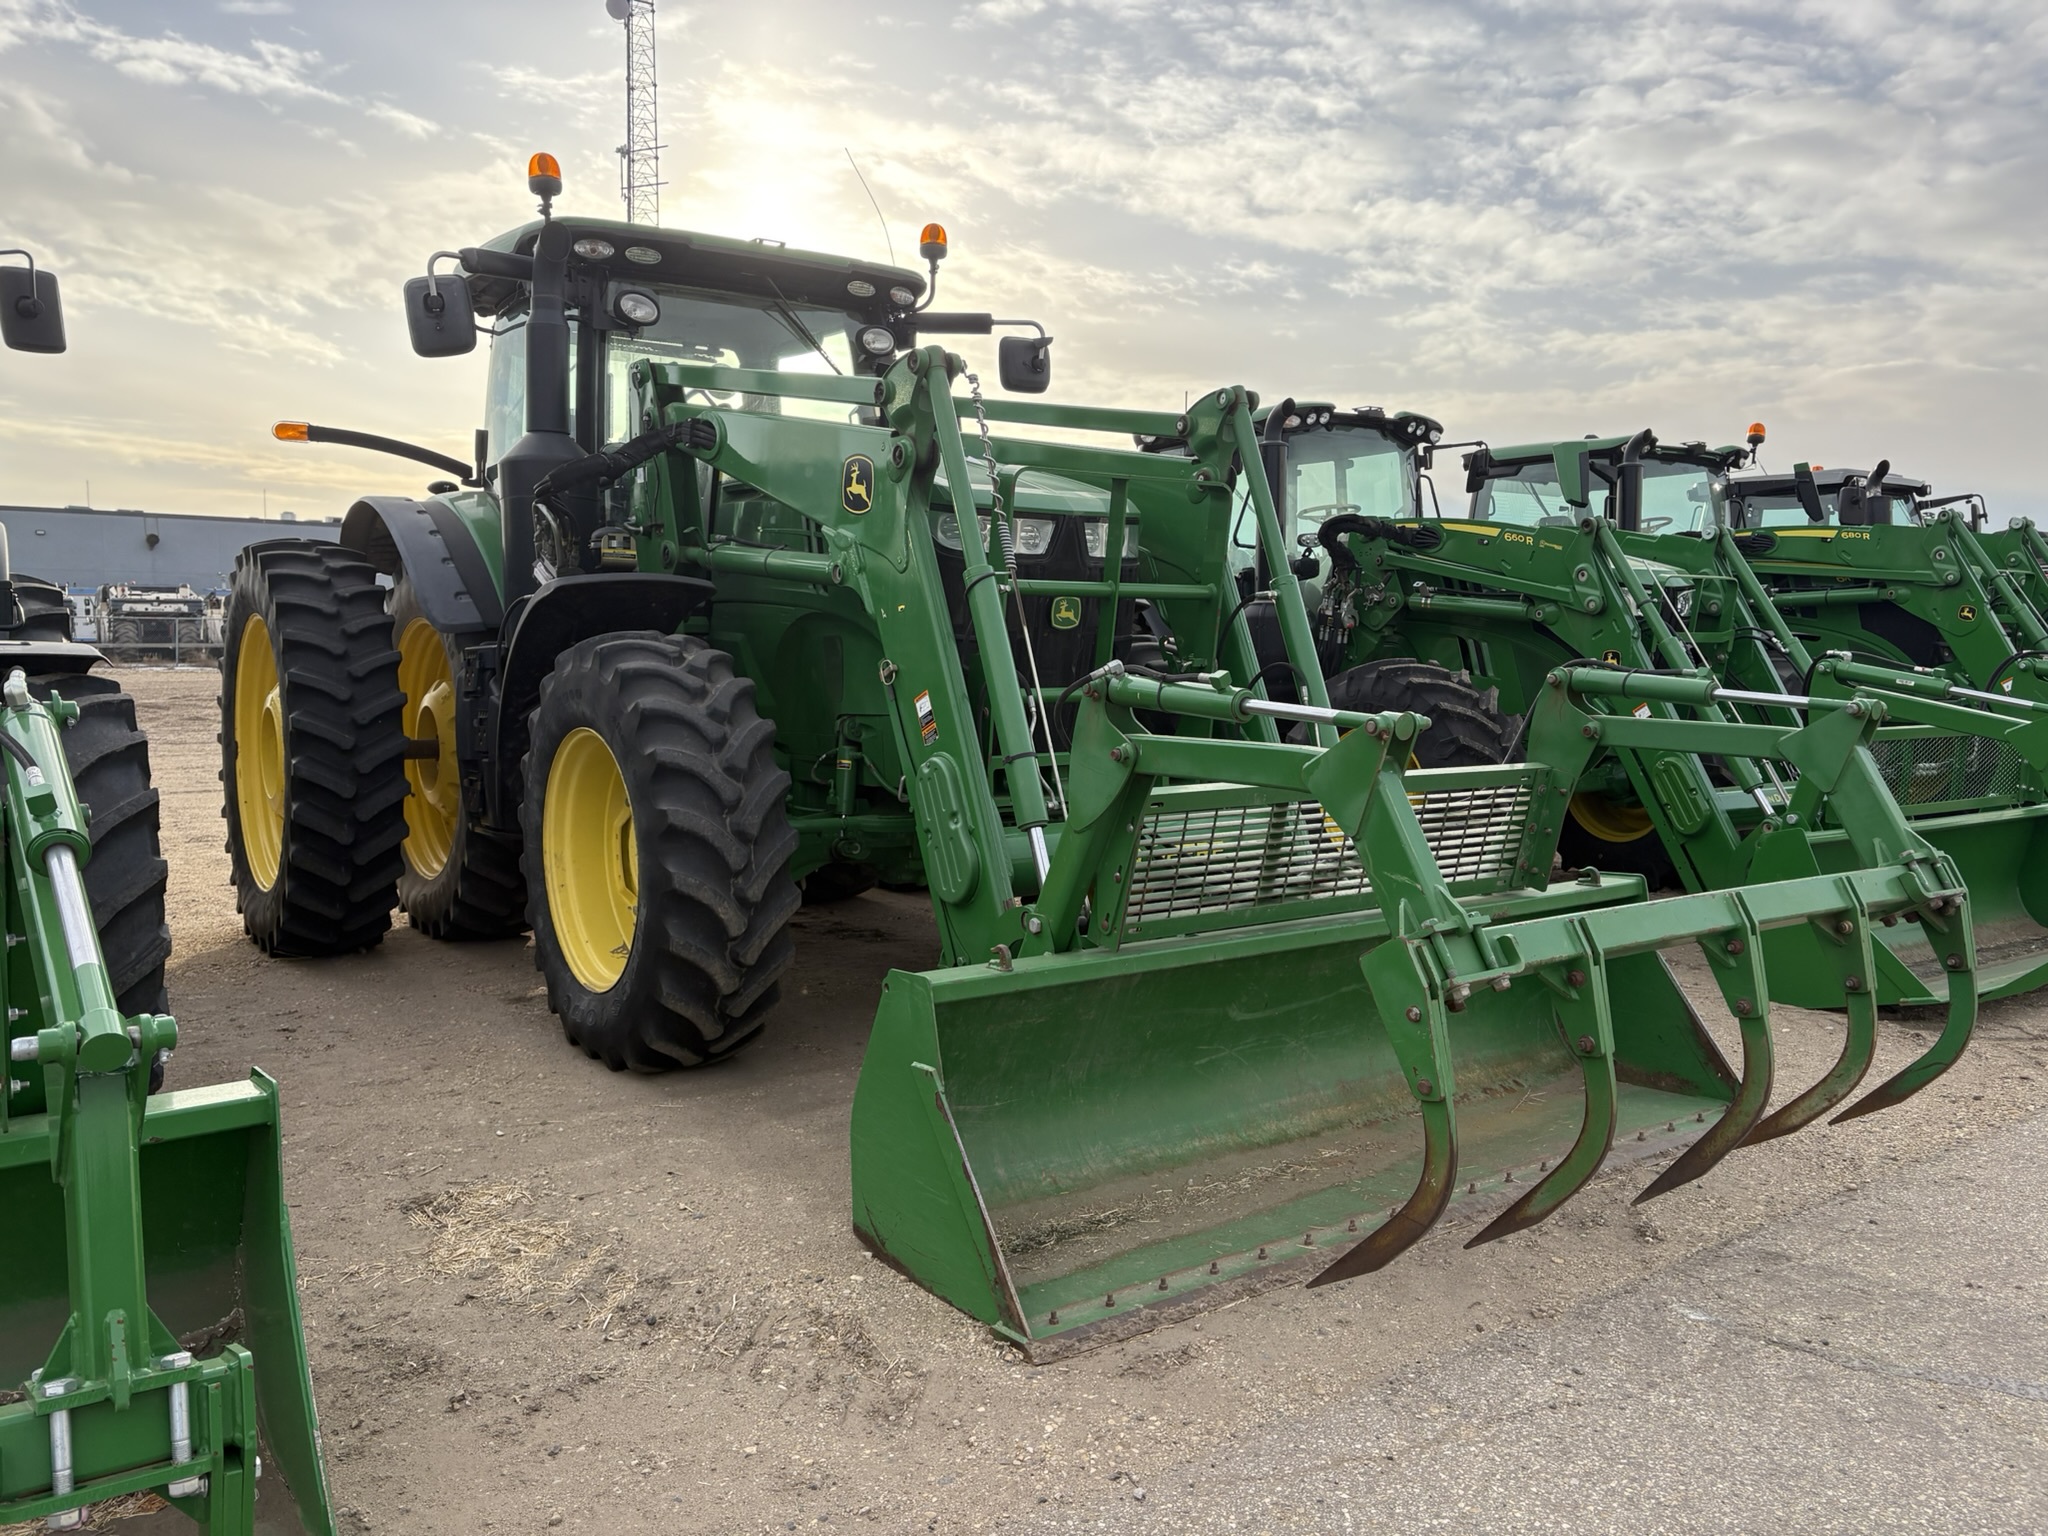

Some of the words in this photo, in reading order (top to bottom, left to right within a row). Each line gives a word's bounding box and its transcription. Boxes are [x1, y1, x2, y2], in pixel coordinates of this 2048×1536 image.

[1504, 533, 1525, 542] 660
[1526, 536, 1533, 545] R
[1862, 532, 1870, 540] R
